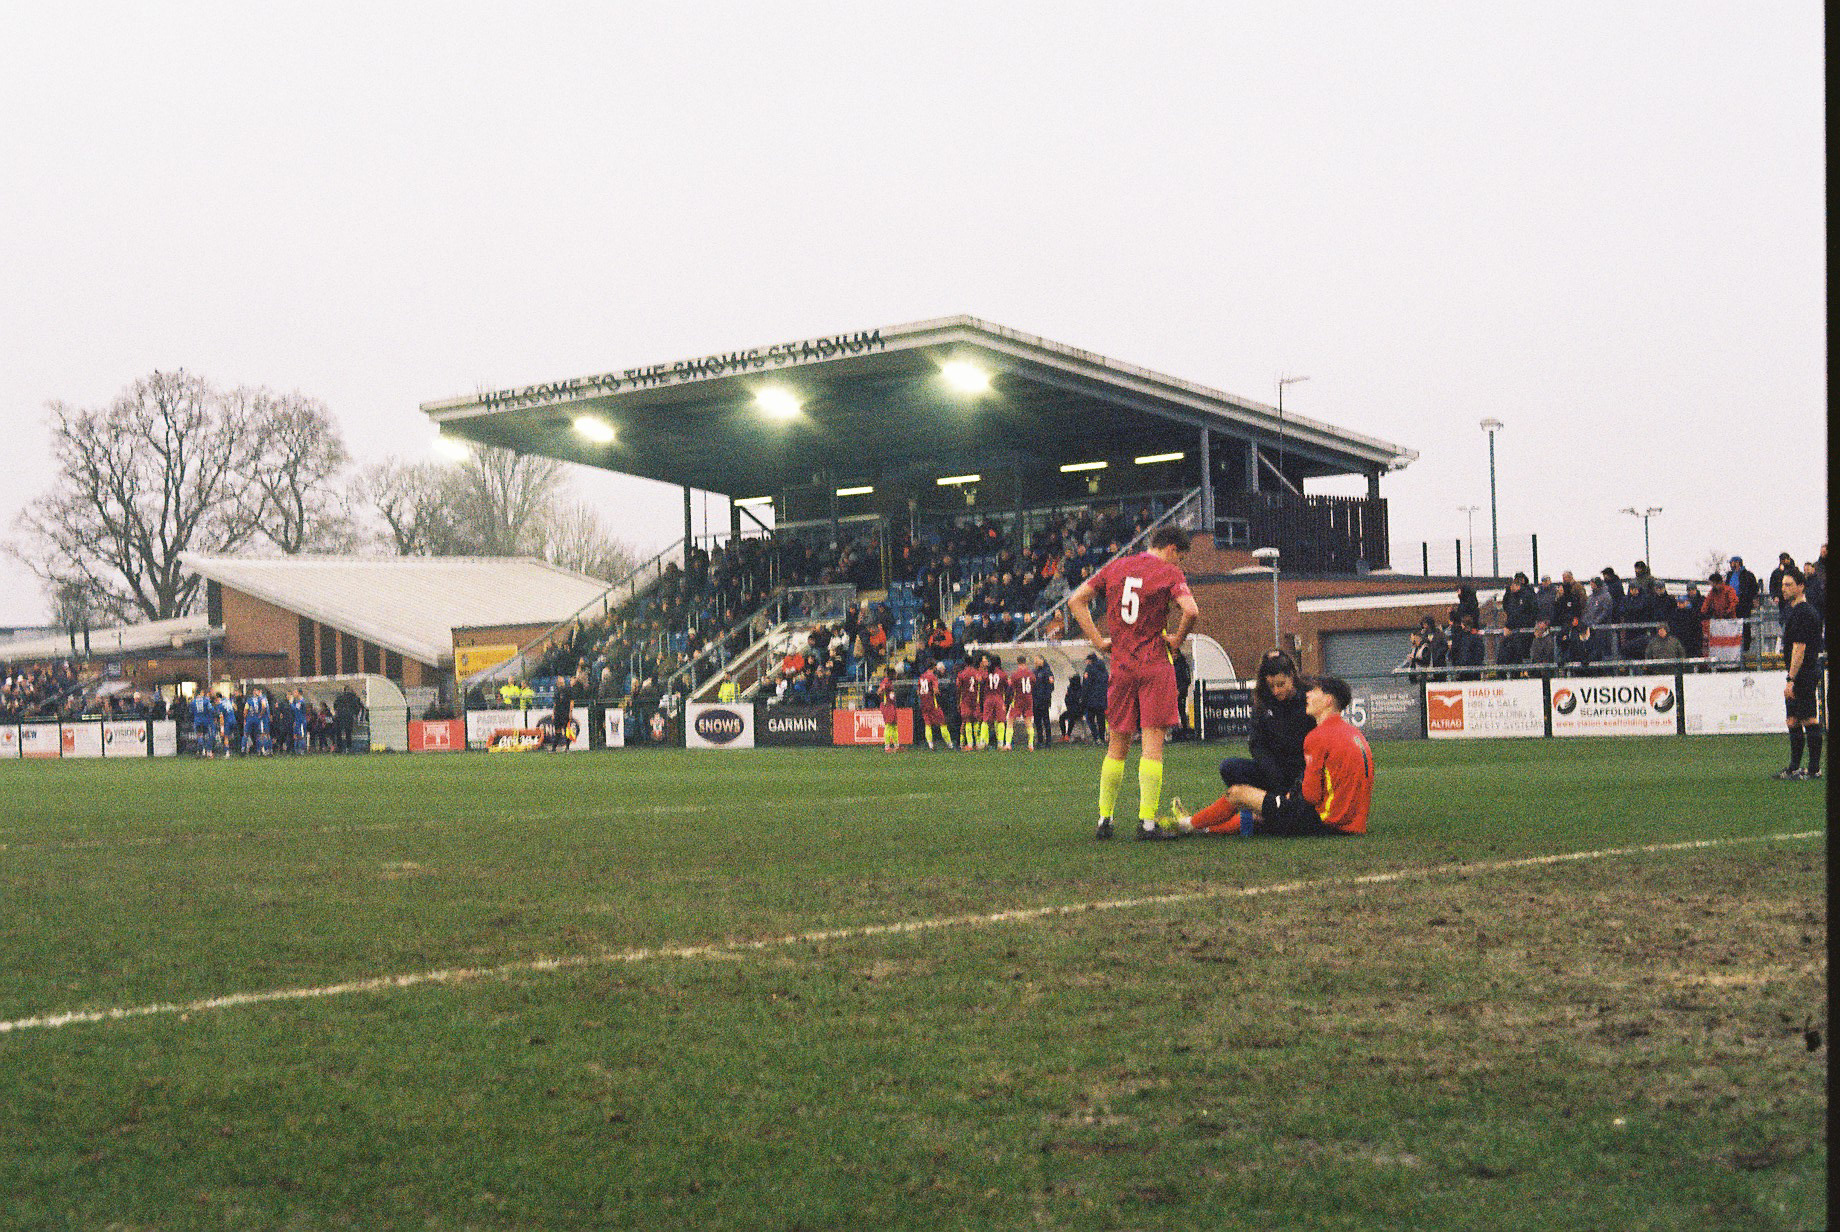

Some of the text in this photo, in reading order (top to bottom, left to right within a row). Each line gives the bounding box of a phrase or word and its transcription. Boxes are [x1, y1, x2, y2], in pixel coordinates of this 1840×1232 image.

[478, 329, 886, 412] WELCOME TO THE SNOWS STADIUM
[1120, 576, 1143, 625] 5
[988, 673, 1000, 690] 19
[1021, 676, 1031, 694] 16
[1580, 686, 1646, 705] VISION
[1580, 706, 1647, 718] SCAFFOLDING
[698, 718, 741, 734] SNOWS
[768, 718, 817, 732] GARMIN
[1430, 718, 1463, 730] ALTRAD
